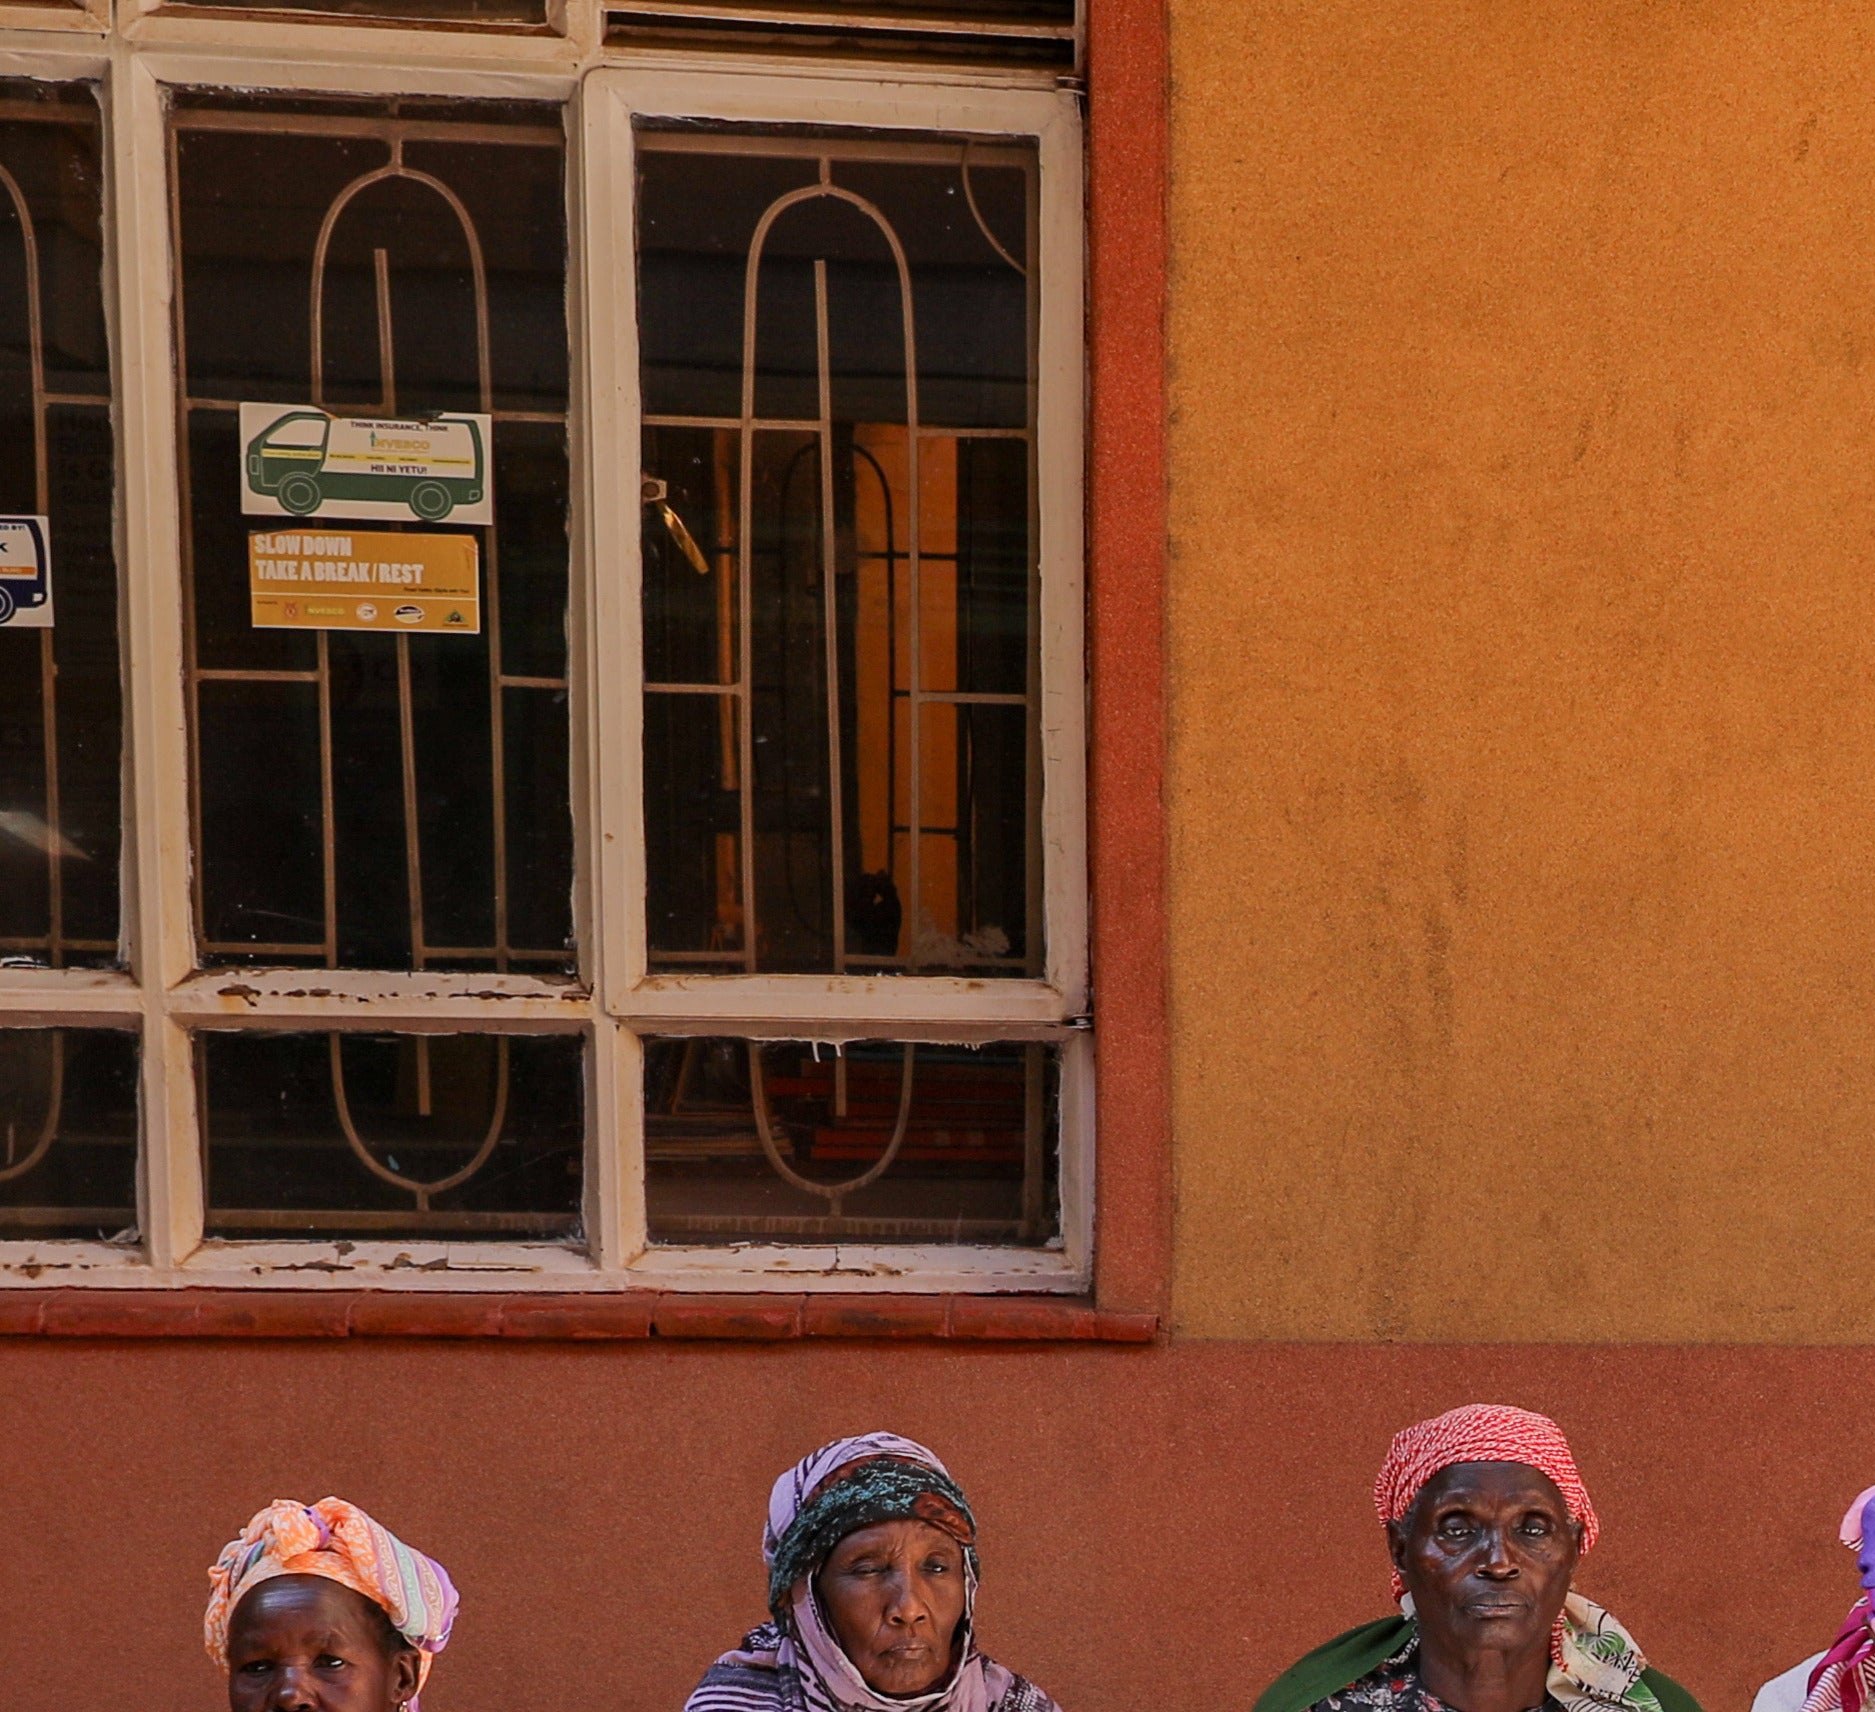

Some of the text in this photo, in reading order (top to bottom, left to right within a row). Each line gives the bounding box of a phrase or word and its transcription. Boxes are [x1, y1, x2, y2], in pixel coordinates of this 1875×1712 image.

[351, 421, 374, 429] THINK
[386, 465, 397, 473] NI
[399, 465, 427, 475] YETU!
[255, 535, 352, 557] SLOW DOWN
[255, 560, 298, 580] TAKE
[301, 562, 313, 581] A
